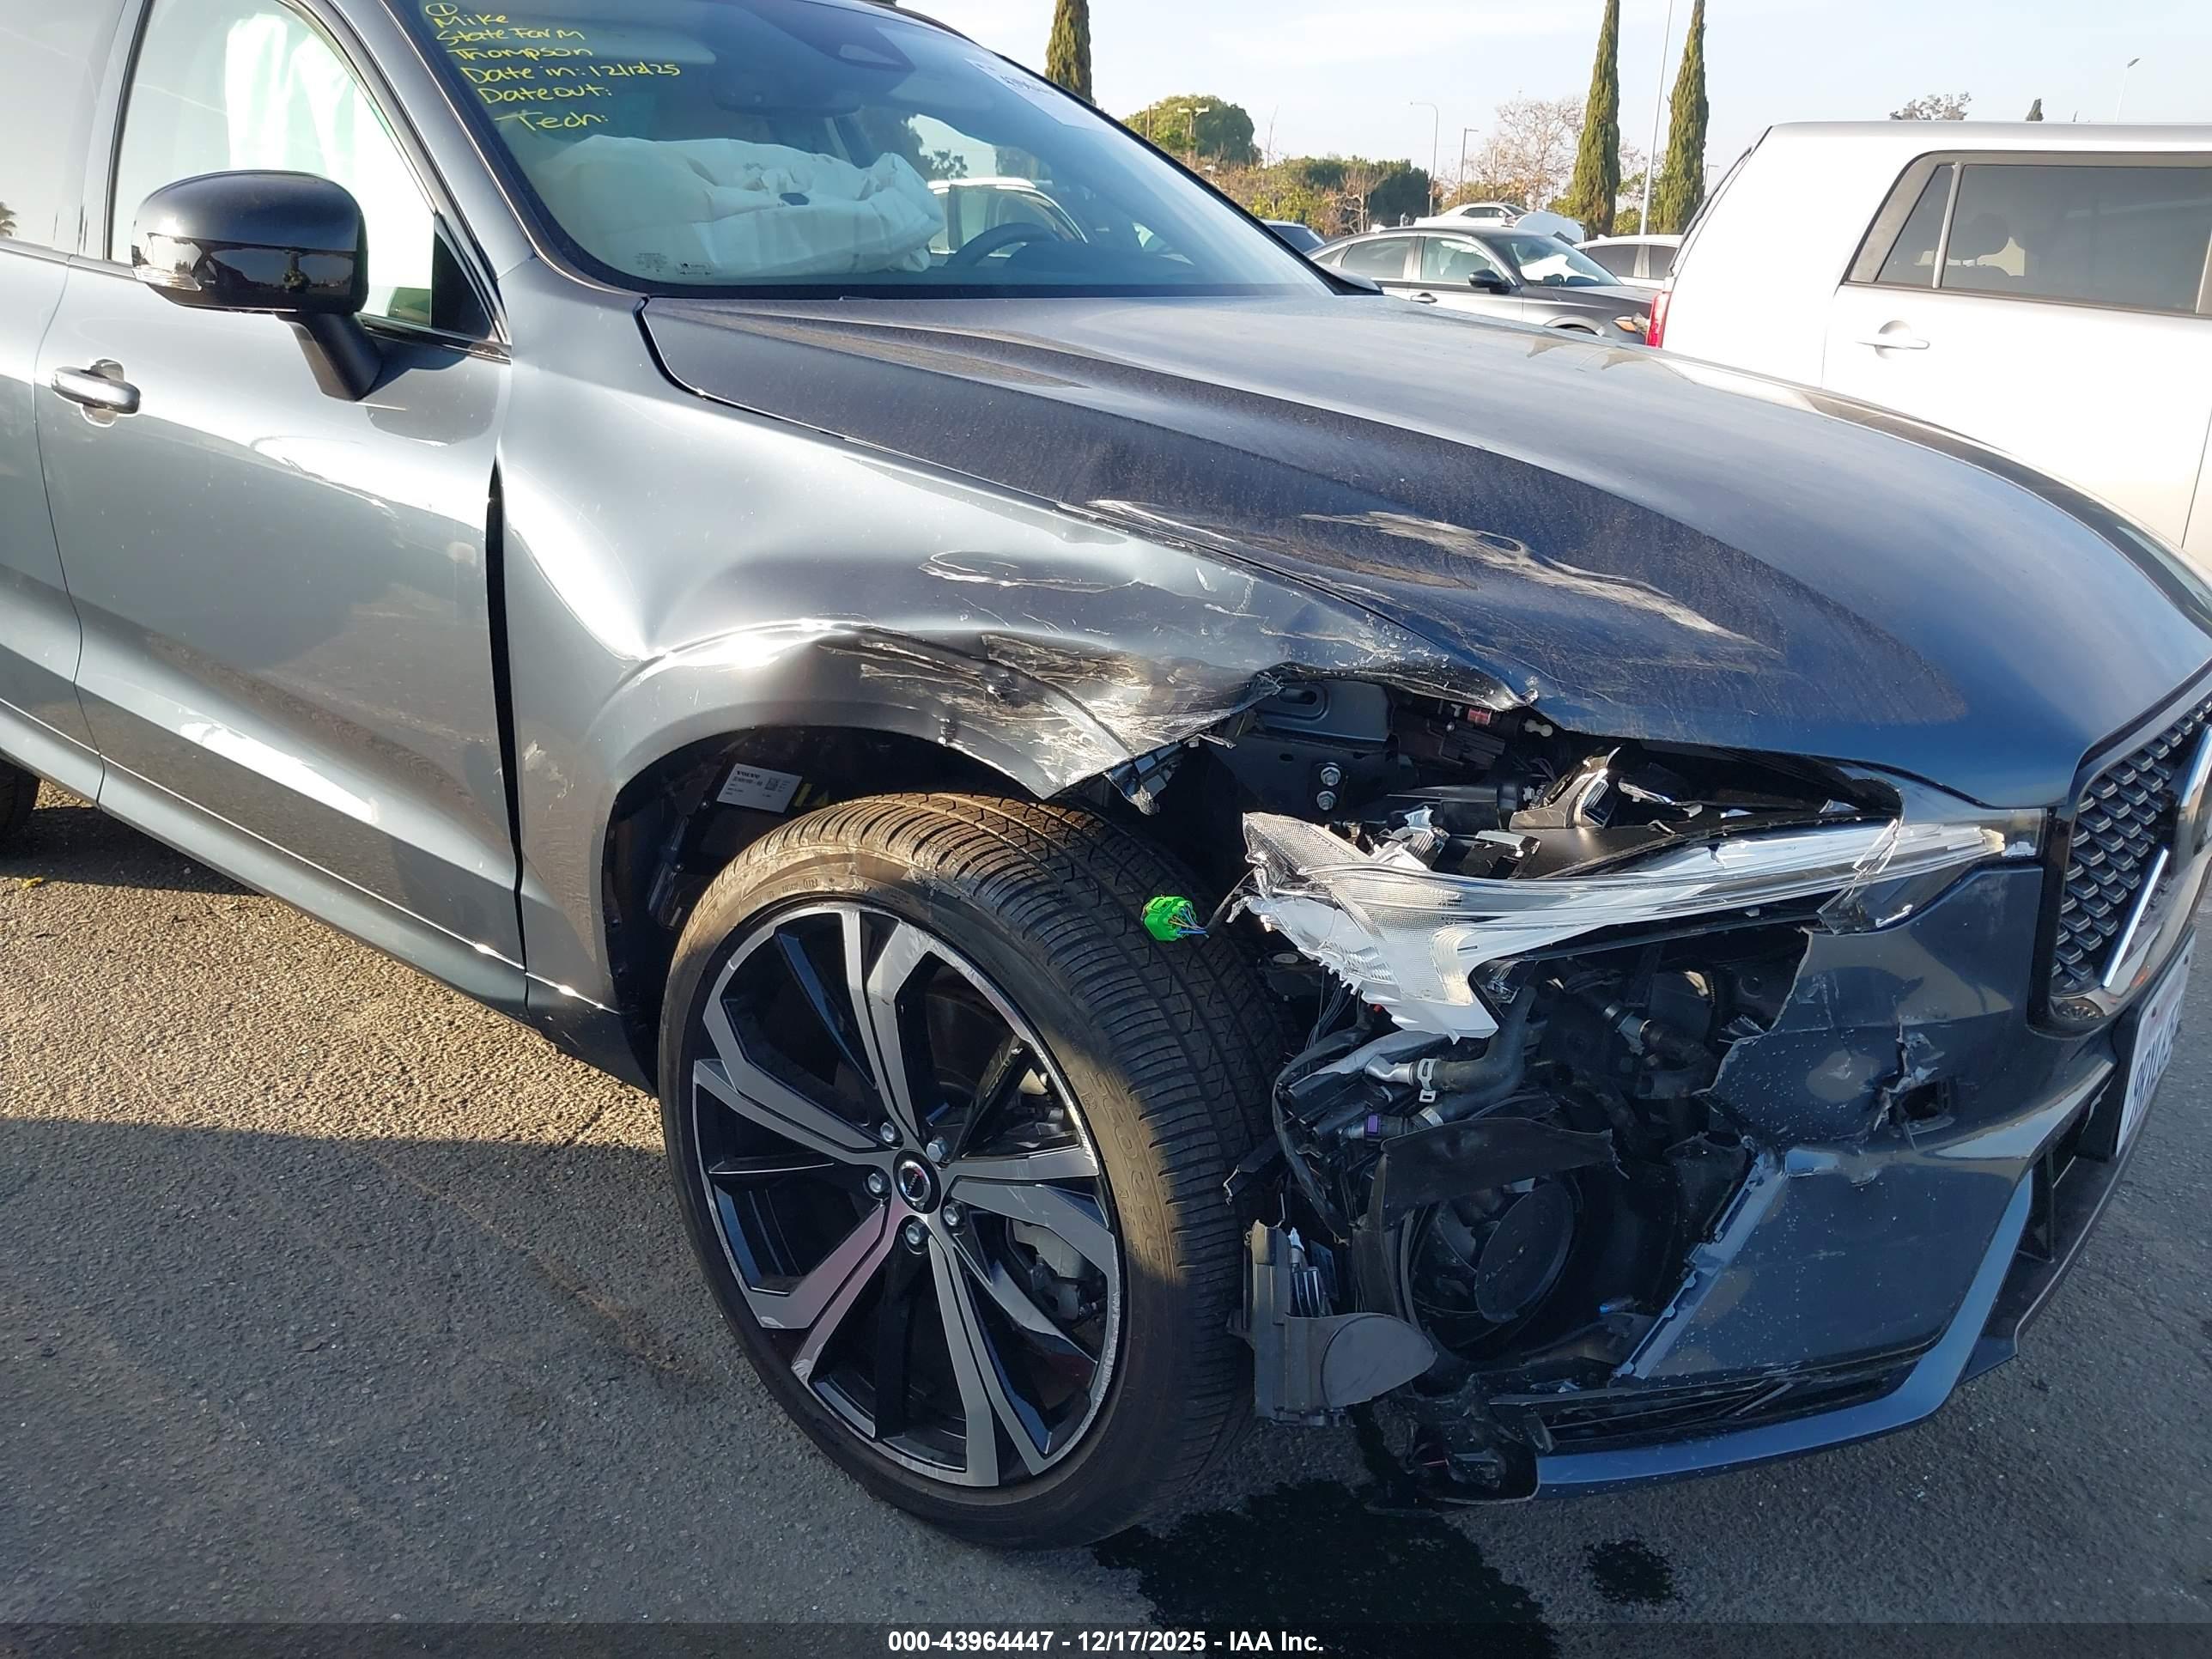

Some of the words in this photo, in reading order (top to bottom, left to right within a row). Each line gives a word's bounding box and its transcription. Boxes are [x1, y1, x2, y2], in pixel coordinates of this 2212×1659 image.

[434, 14, 509, 28] Mike
[436, 28, 509, 46] State
[447, 47, 593, 61] Thompson
[460, 66, 535, 84] Date
[477, 87, 554, 104] Date
[553, 84, 612, 97] out:
[494, 109, 609, 131] Tech:
